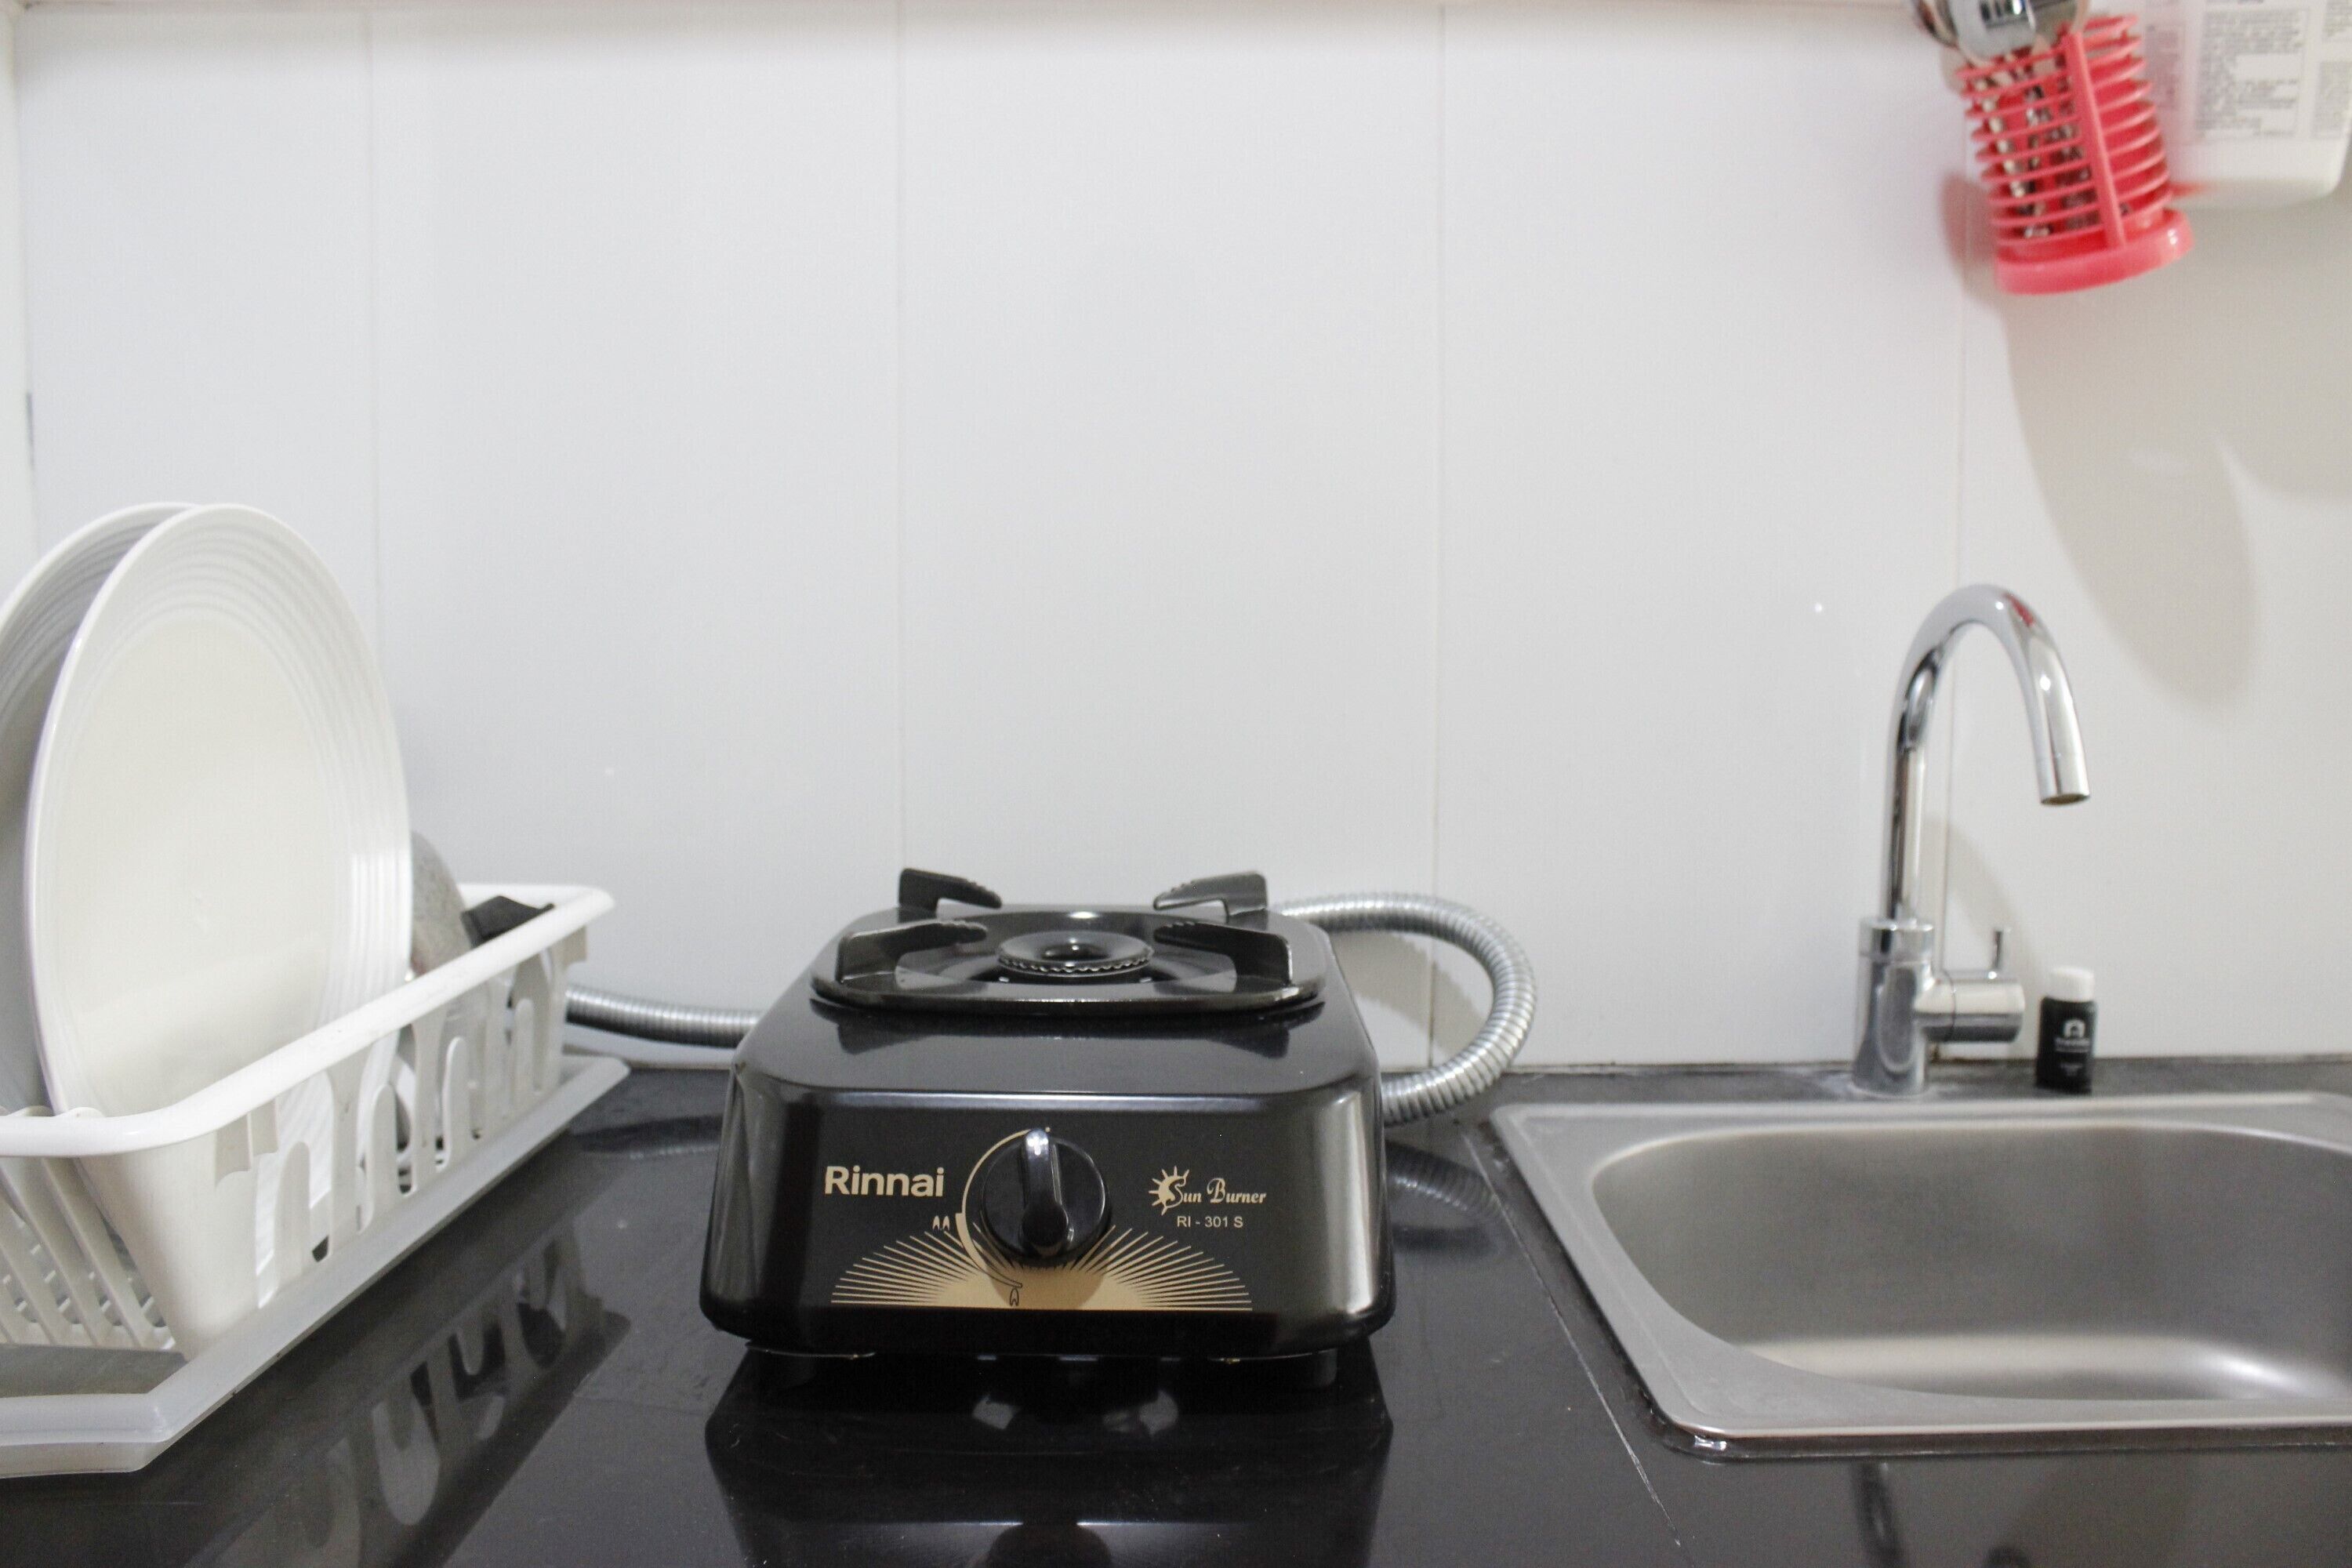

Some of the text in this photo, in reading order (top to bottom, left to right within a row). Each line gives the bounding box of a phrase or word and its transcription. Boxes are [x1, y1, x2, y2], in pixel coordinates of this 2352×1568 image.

[825, 1165, 945, 1197] Rinnai
[1156, 1173, 1267, 1210] Sun Burner
[1177, 1215, 1192, 1228] RI
[1204, 1215, 1229, 1229] 301
[1233, 1215, 1243, 1229] S
